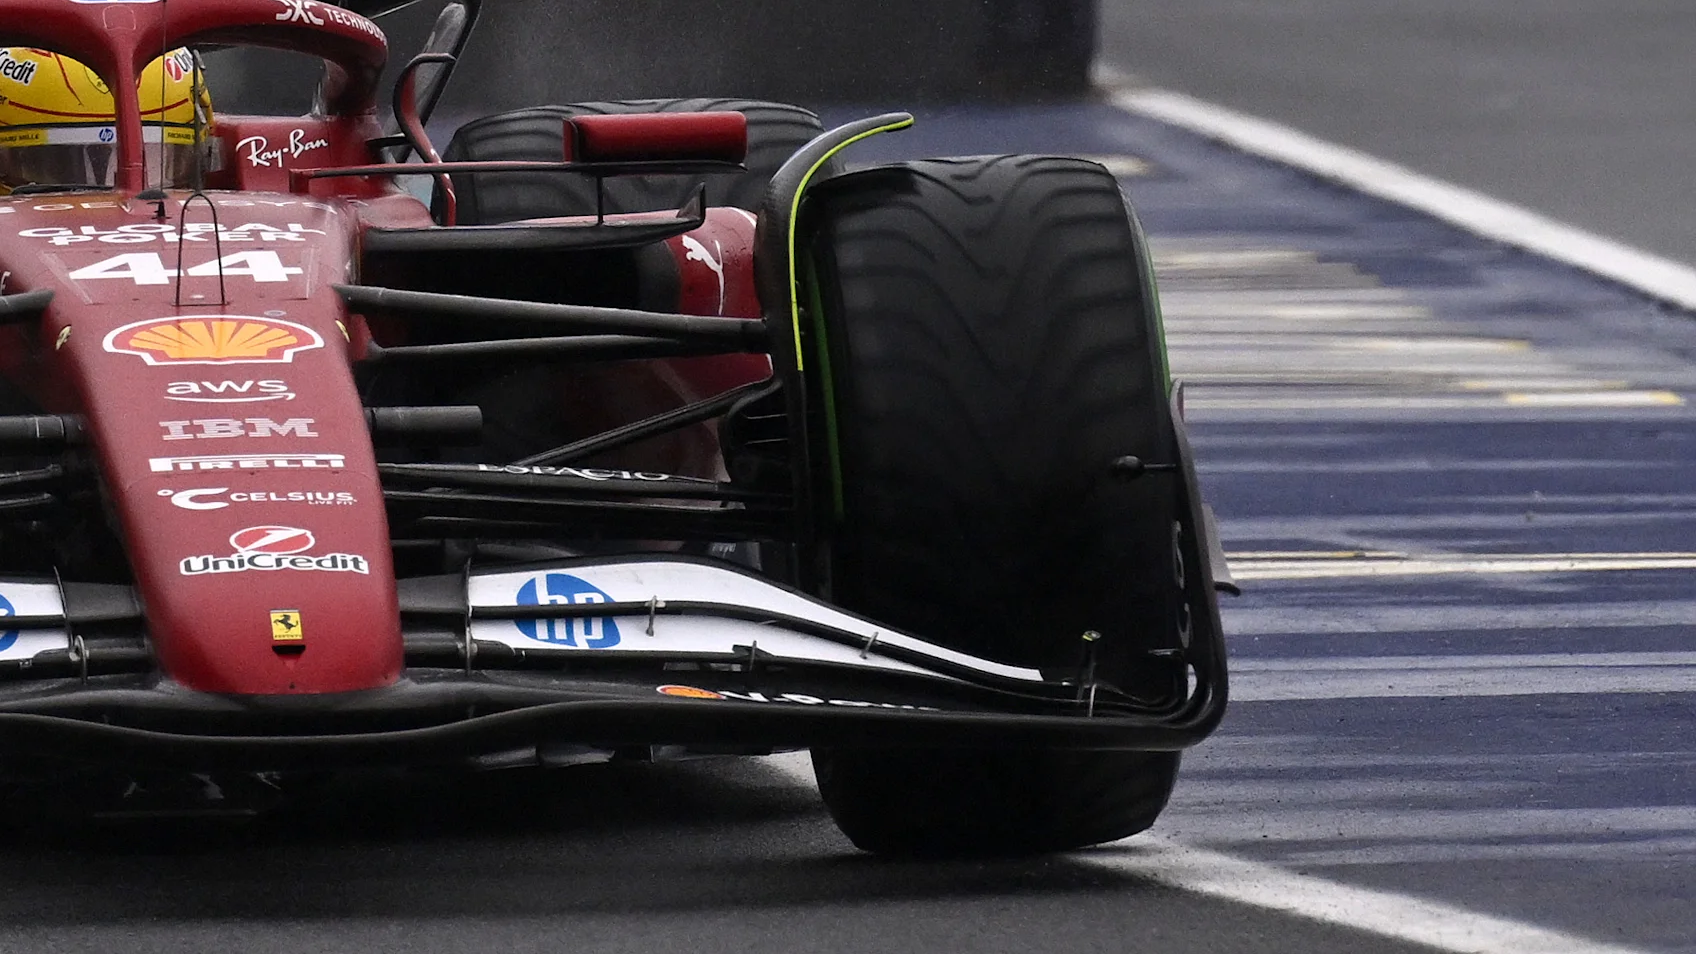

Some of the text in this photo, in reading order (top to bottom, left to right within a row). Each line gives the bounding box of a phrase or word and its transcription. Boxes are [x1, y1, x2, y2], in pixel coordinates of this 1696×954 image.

[99, 128, 114, 142] hp
[235, 129, 328, 168] Ray-Ban
[18, 223, 326, 237] GLOBAL
[48, 232, 306, 245] POKER
[68, 250, 304, 285] 44
[166, 380, 289, 395] aws
[159, 418, 319, 440] IBM
[148, 454, 346, 472] PIRELLI
[230, 492, 355, 502] CELSIUS
[182, 553, 367, 574] UniCredit
[530, 574, 609, 648] hp
